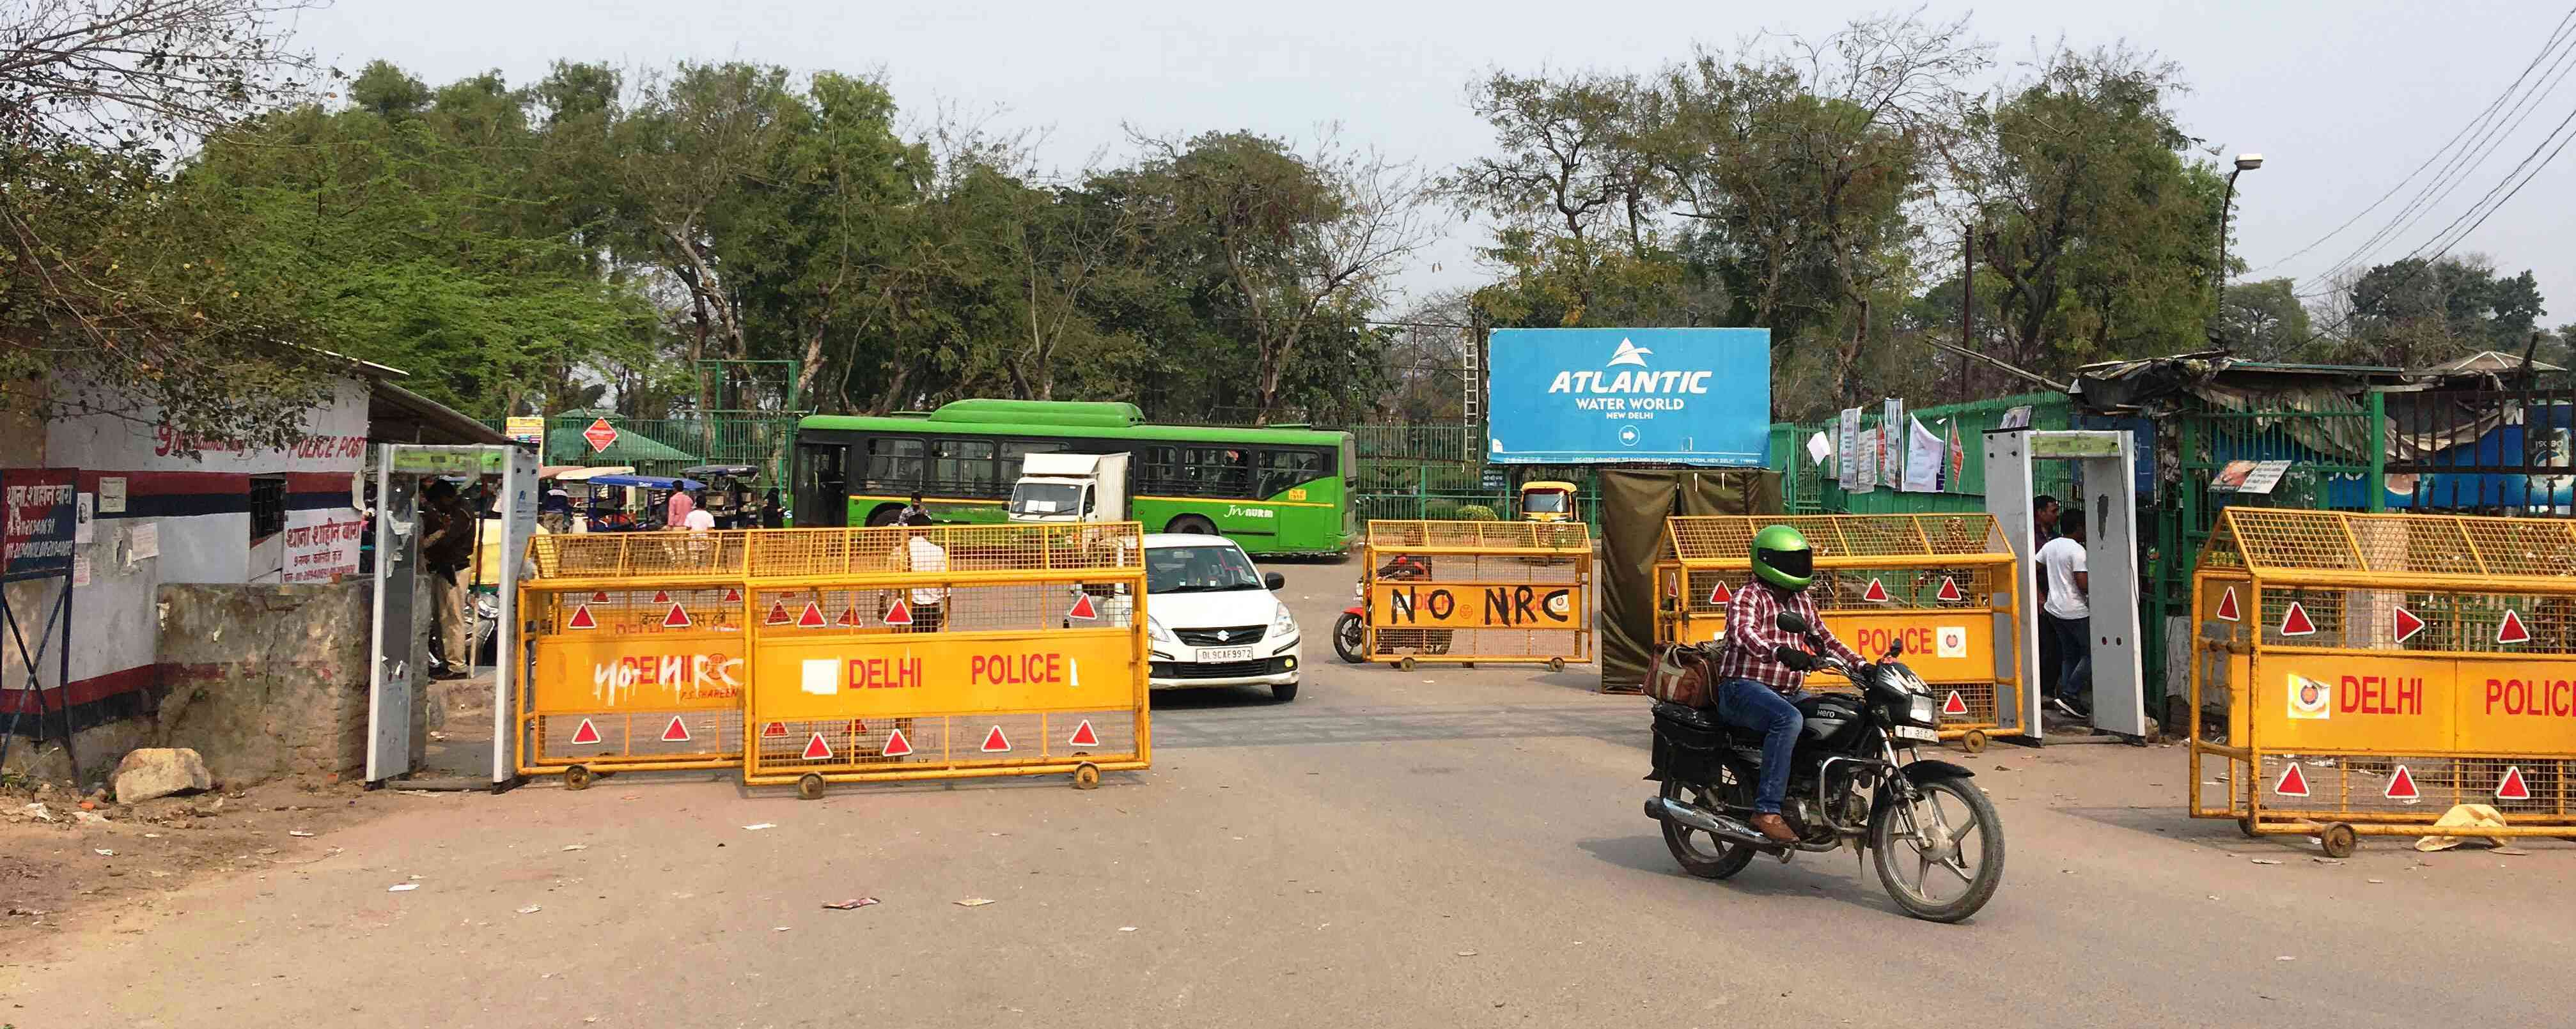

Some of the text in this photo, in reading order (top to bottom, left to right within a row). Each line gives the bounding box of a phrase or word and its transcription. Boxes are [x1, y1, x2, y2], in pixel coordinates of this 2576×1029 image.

[1548, 371, 1713, 394] ATLANTIC
[1575, 398, 1685, 410] WATER WORLD
[336, 436, 368, 459] POST
[1391, 585, 1570, 628] NO NRC
[1857, 628, 1933, 655] POLICE
[849, 653, 1061, 689] DELHI POLICE
[2340, 675, 2576, 717] DELHI POLIC
